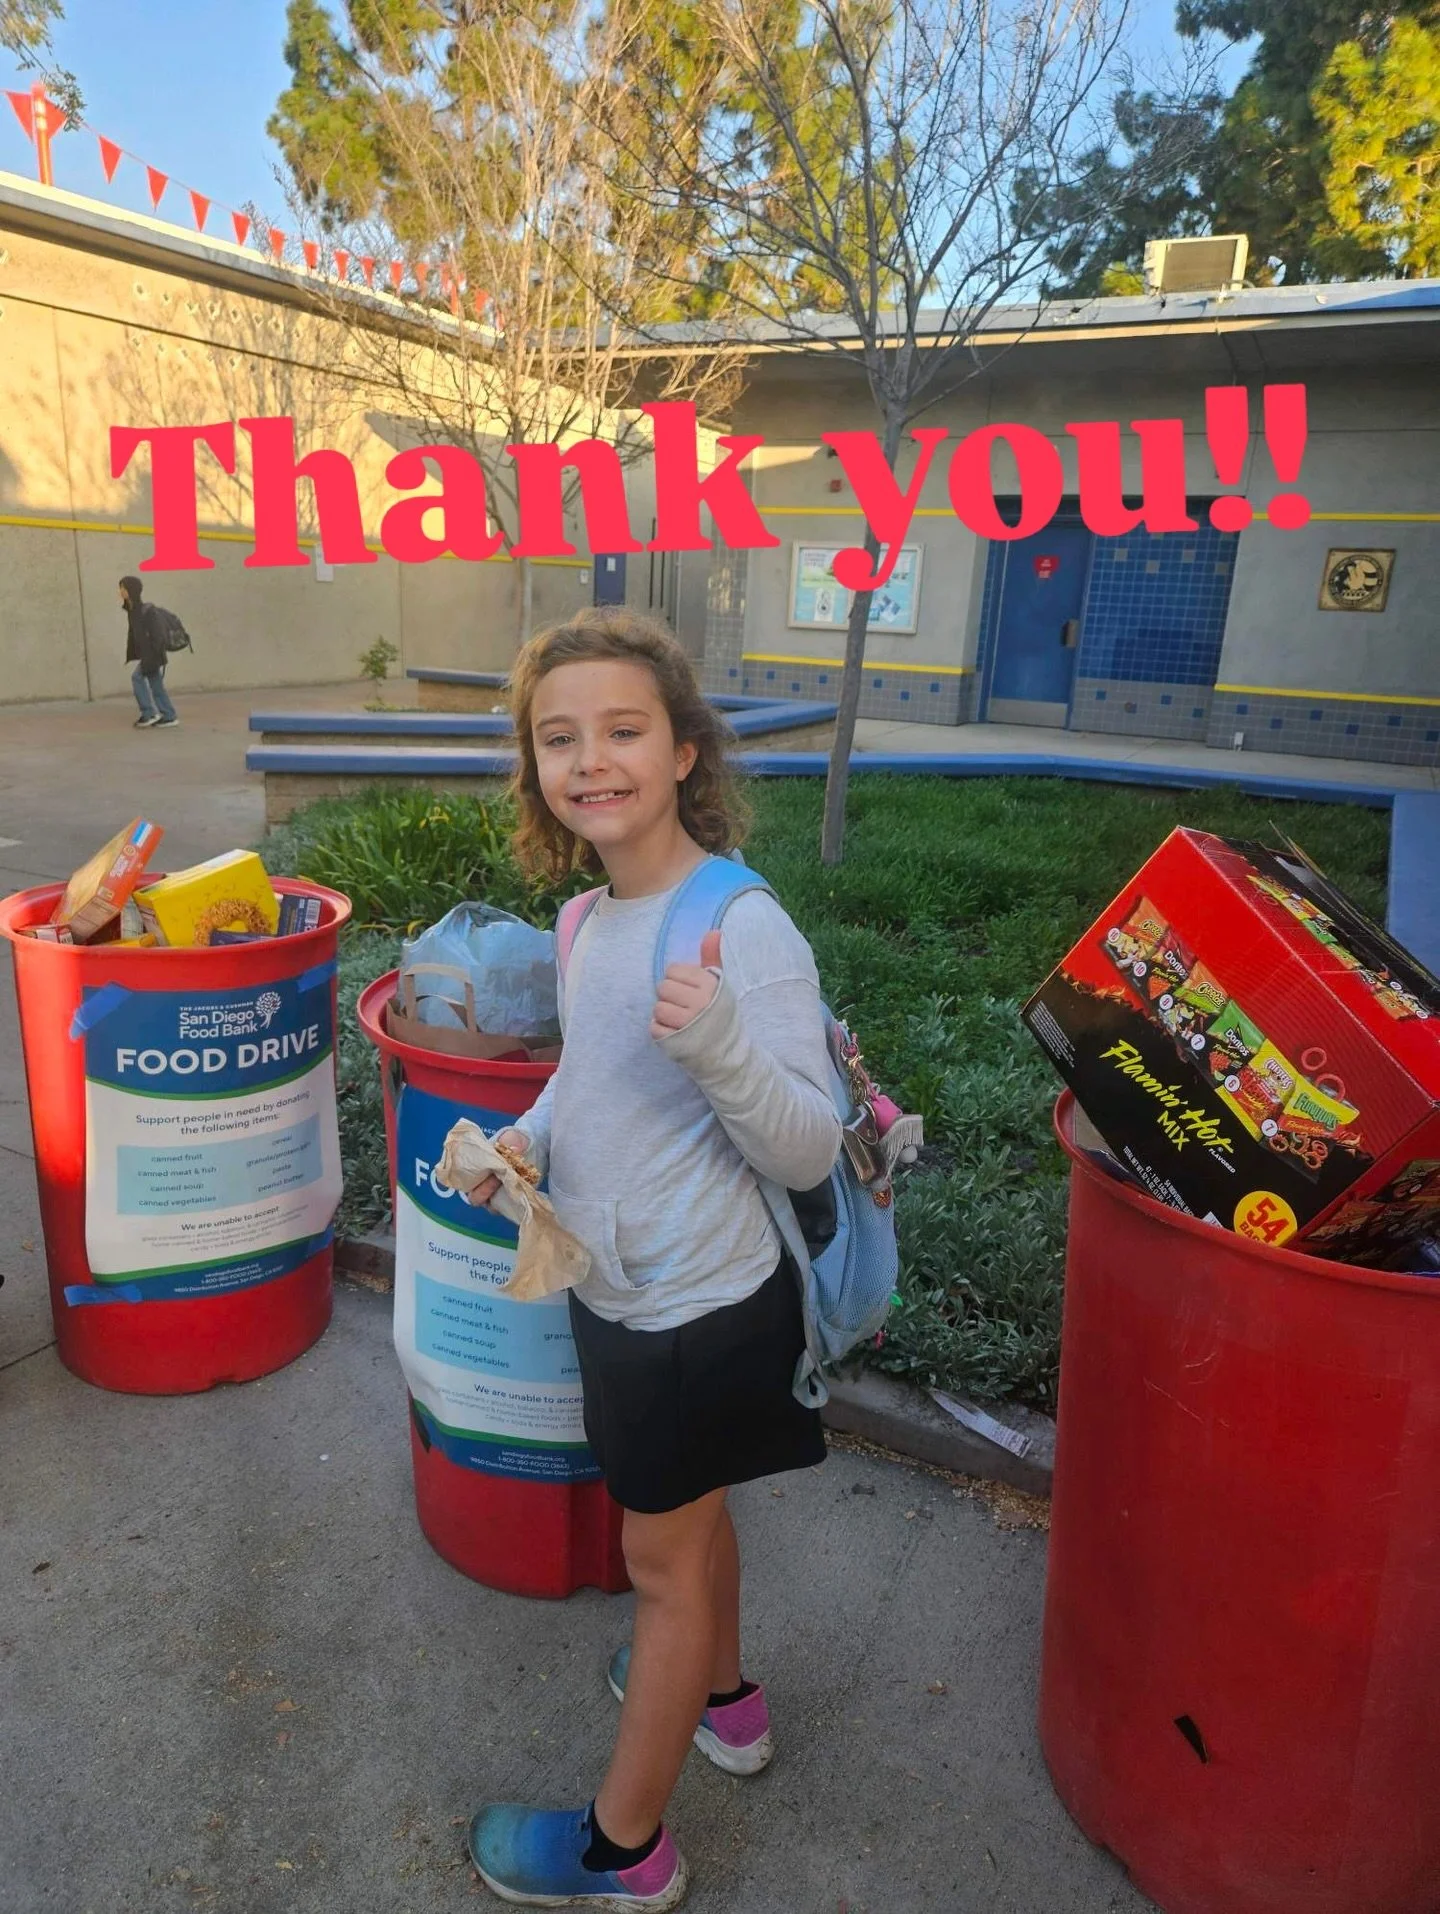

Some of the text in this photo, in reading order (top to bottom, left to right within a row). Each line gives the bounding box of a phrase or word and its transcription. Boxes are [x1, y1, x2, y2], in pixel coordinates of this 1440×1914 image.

[1196, 982, 1226, 1008] Cheetos
[179, 1010, 255, 1026] San Diego
[179, 1021, 258, 1039] Food Bank
[116, 1023, 320, 1075] FOOD DRIVE
[1225, 1028, 1250, 1057] Doritos
[136, 1090, 310, 1127] Support people in need by donating
[1099, 1039, 1189, 1108] Flamin'
[1178, 1109, 1235, 1154] Hot
[180, 1113, 281, 1136] the following items:
[1157, 1110, 1190, 1153] MIX
[151, 1152, 203, 1162] canned fruit
[1207, 1148, 1237, 1174] FLAVORED
[137, 1169, 168, 1177] canned
[170, 1168, 192, 1176] meat
[138, 1199, 169, 1208] canned
[181, 1223, 197, 1232] We
[198, 1221, 212, 1229] are
[214, 1216, 241, 1227] unable
[254, 1206, 279, 1219] accept
[1246, 1197, 1290, 1243] 54
[428, 1241, 512, 1274] Support people
[470, 1268, 488, 1282] the
[442, 1294, 493, 1315] canned fruit
[431, 1307, 509, 1335] canned meat & fish
[442, 1329, 497, 1350] canned soup
[432, 1342, 510, 1370] canned vegetables
[474, 1384, 585, 1405] We are unable to accep
